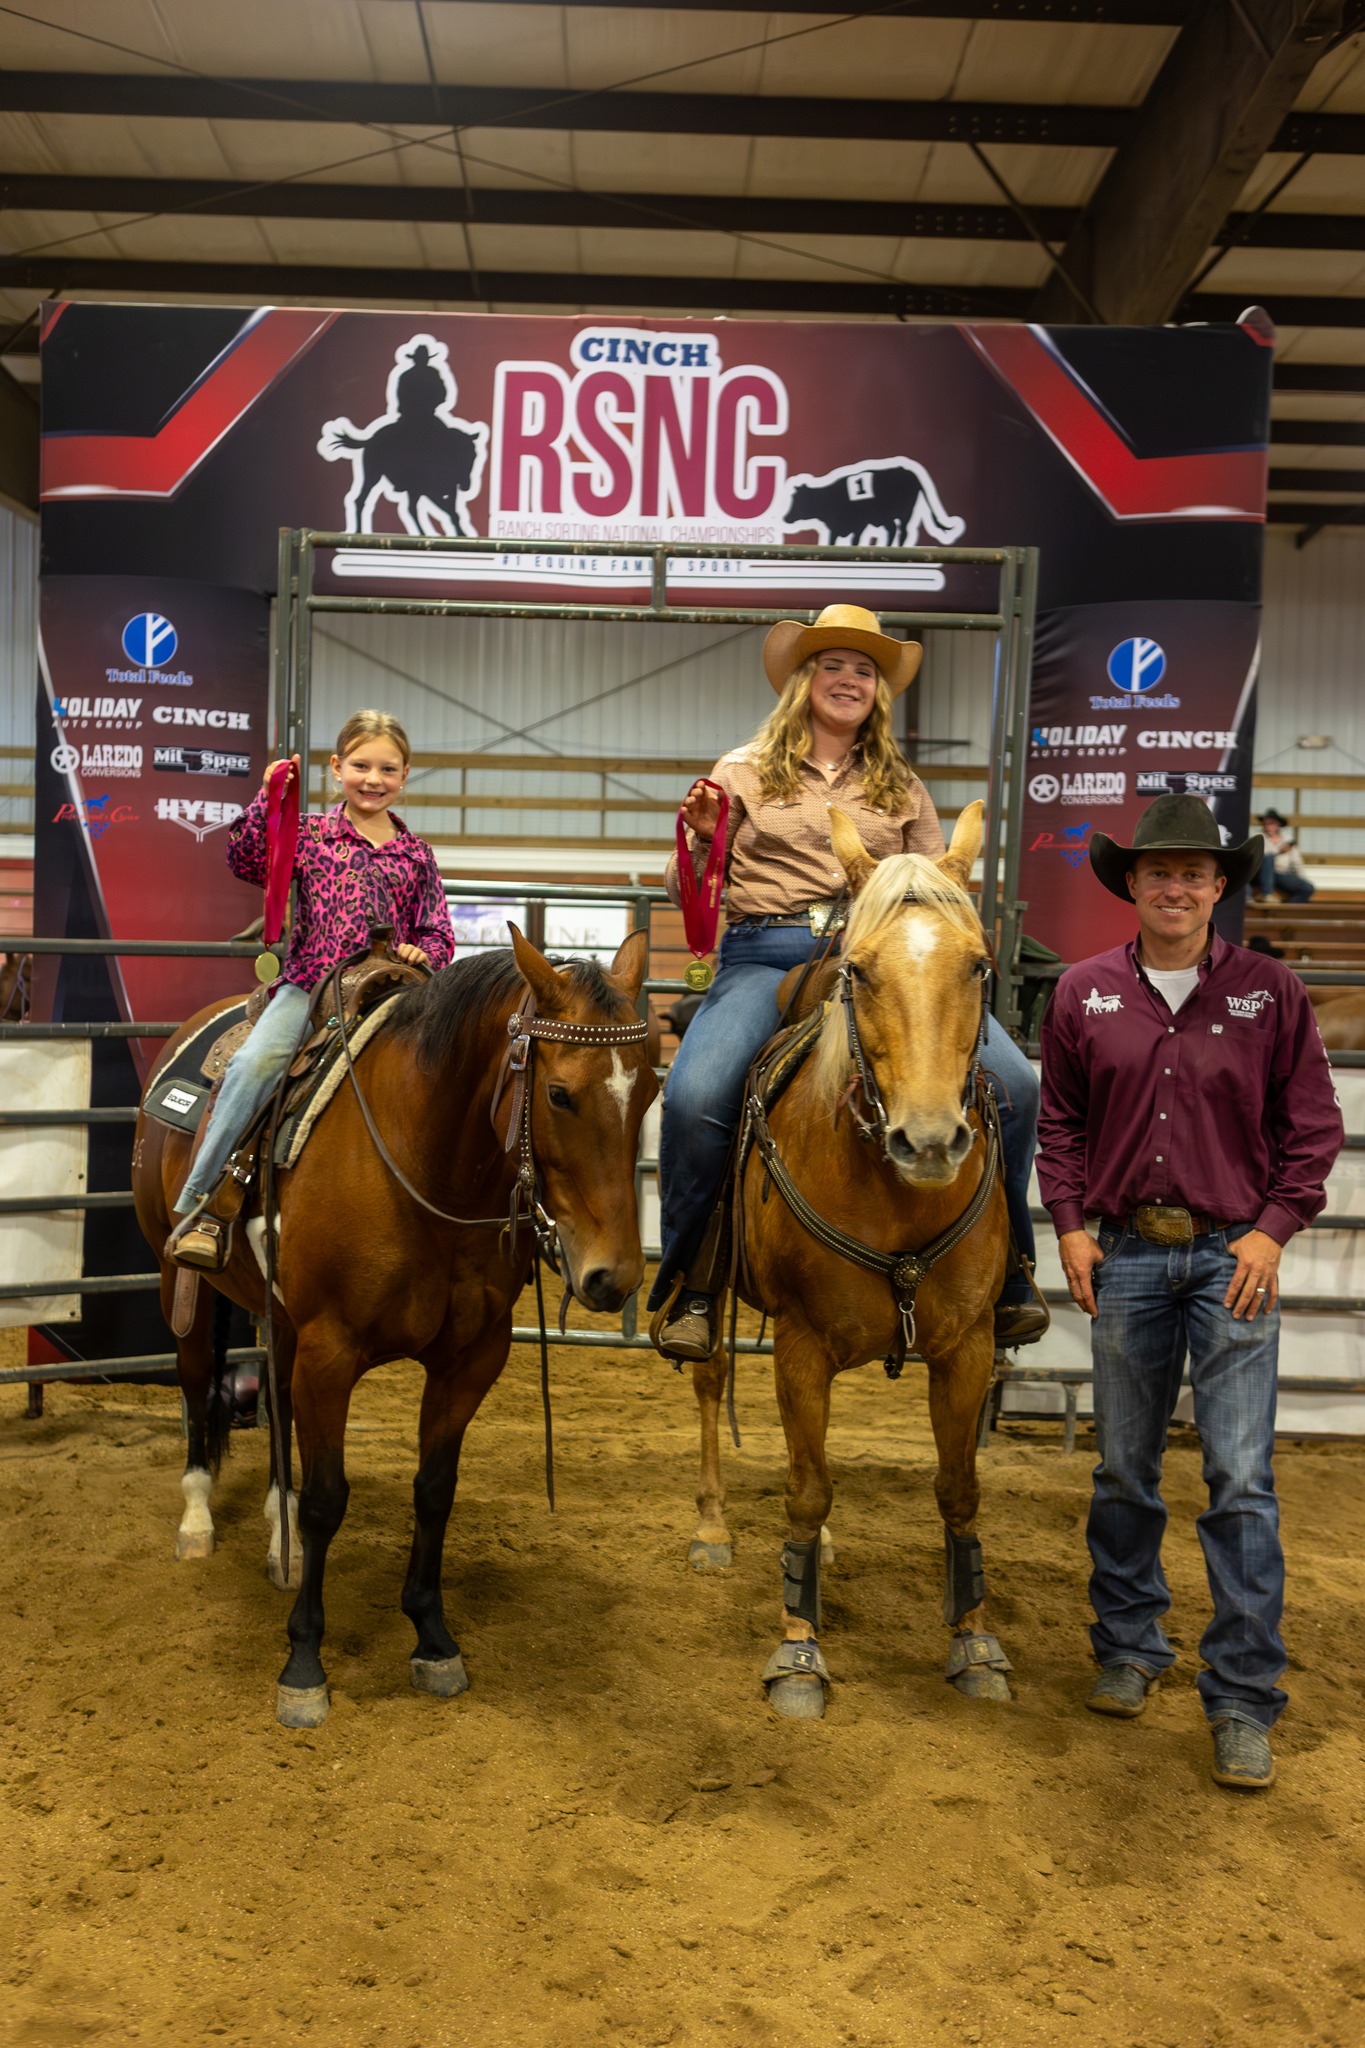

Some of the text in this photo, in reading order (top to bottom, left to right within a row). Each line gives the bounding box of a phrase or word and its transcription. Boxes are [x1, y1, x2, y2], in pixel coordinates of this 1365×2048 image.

[580, 337, 710, 367] CINCH
[499, 371, 779, 518] RSNC
[497, 519, 777, 544] RANCH SORTING NATIONAL CHAMPIONSHIPS
[502, 555, 743, 573] #1 EQUINE FAMIY SPORT
[106, 668, 193, 686] Total Feeds
[52, 696, 143, 719] HOLIDAY
[1089, 693, 1180, 709] Total Feeds
[51, 719, 143, 730] AUTO GROUP
[152, 706, 251, 731] CINCH
[1031, 724, 1127, 747] HOLIDAY
[1136, 730, 1238, 749] CINCH
[81, 744, 143, 768] LAREDO
[154, 749, 250, 769] Mil Spec
[1031, 747, 1127, 758] AUTO GROUP
[80, 766, 142, 778] CONVERSIONS
[1136, 773, 1237, 790] Mil Spec
[1061, 772, 1127, 796] LAREDO
[1060, 794, 1124, 805] CONVERSIONS
[1225, 995, 1261, 1013] WSP
